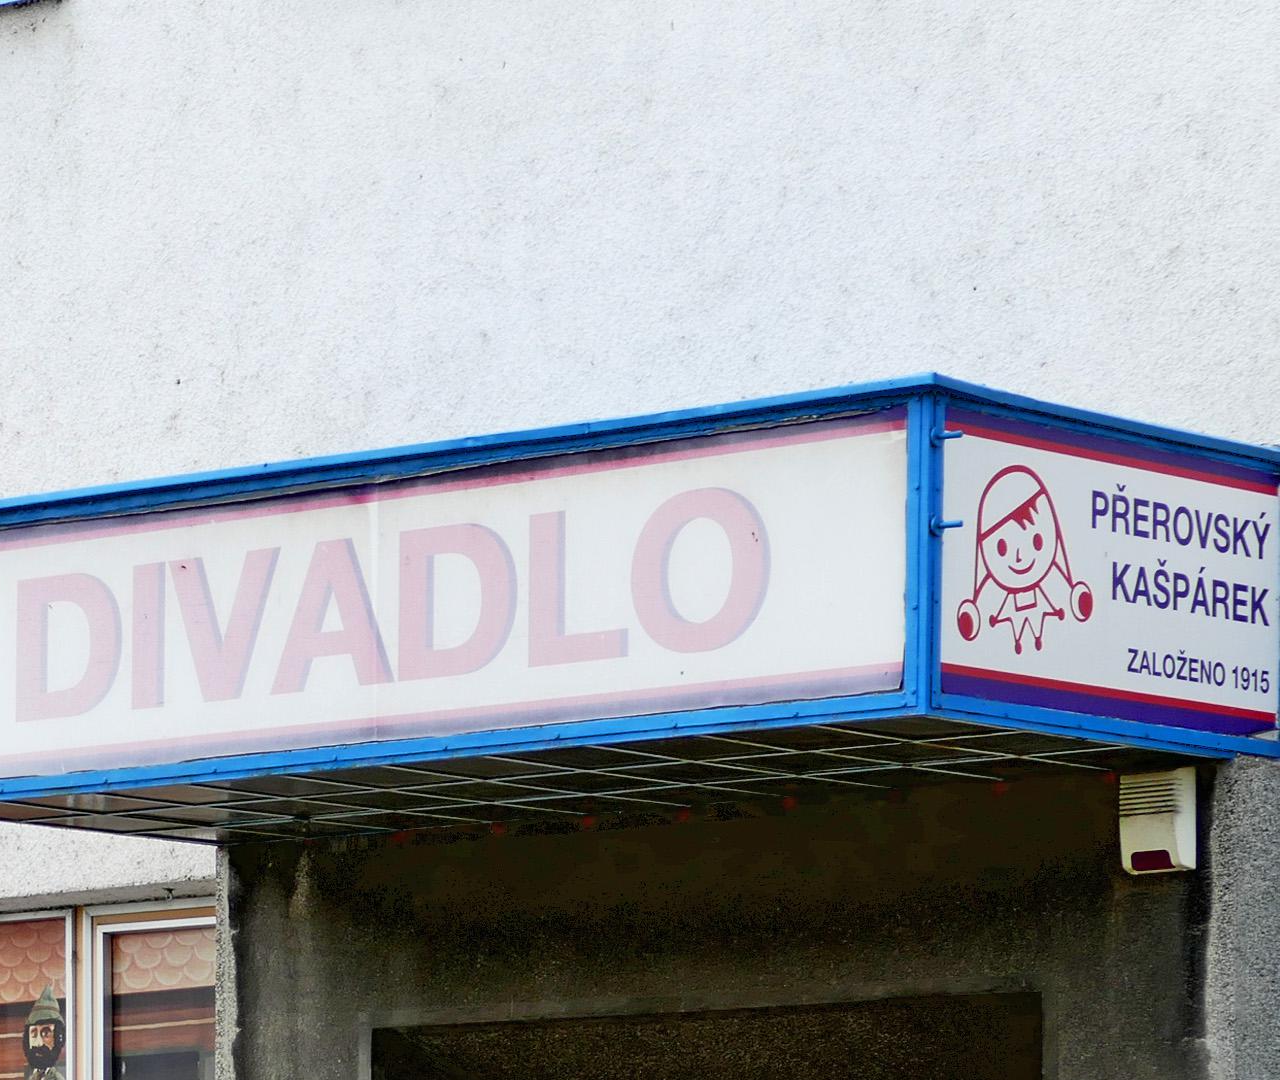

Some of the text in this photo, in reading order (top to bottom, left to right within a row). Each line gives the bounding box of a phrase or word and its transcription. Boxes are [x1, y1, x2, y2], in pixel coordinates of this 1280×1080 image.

[1091, 483, 1271, 560] PŘEROVSKÝ
[14, 486, 772, 724] DIVADLO
[1111, 559, 1271, 627] KAŠPÁREK
[1127, 648, 1270, 694] ZALOŽENO 1915
